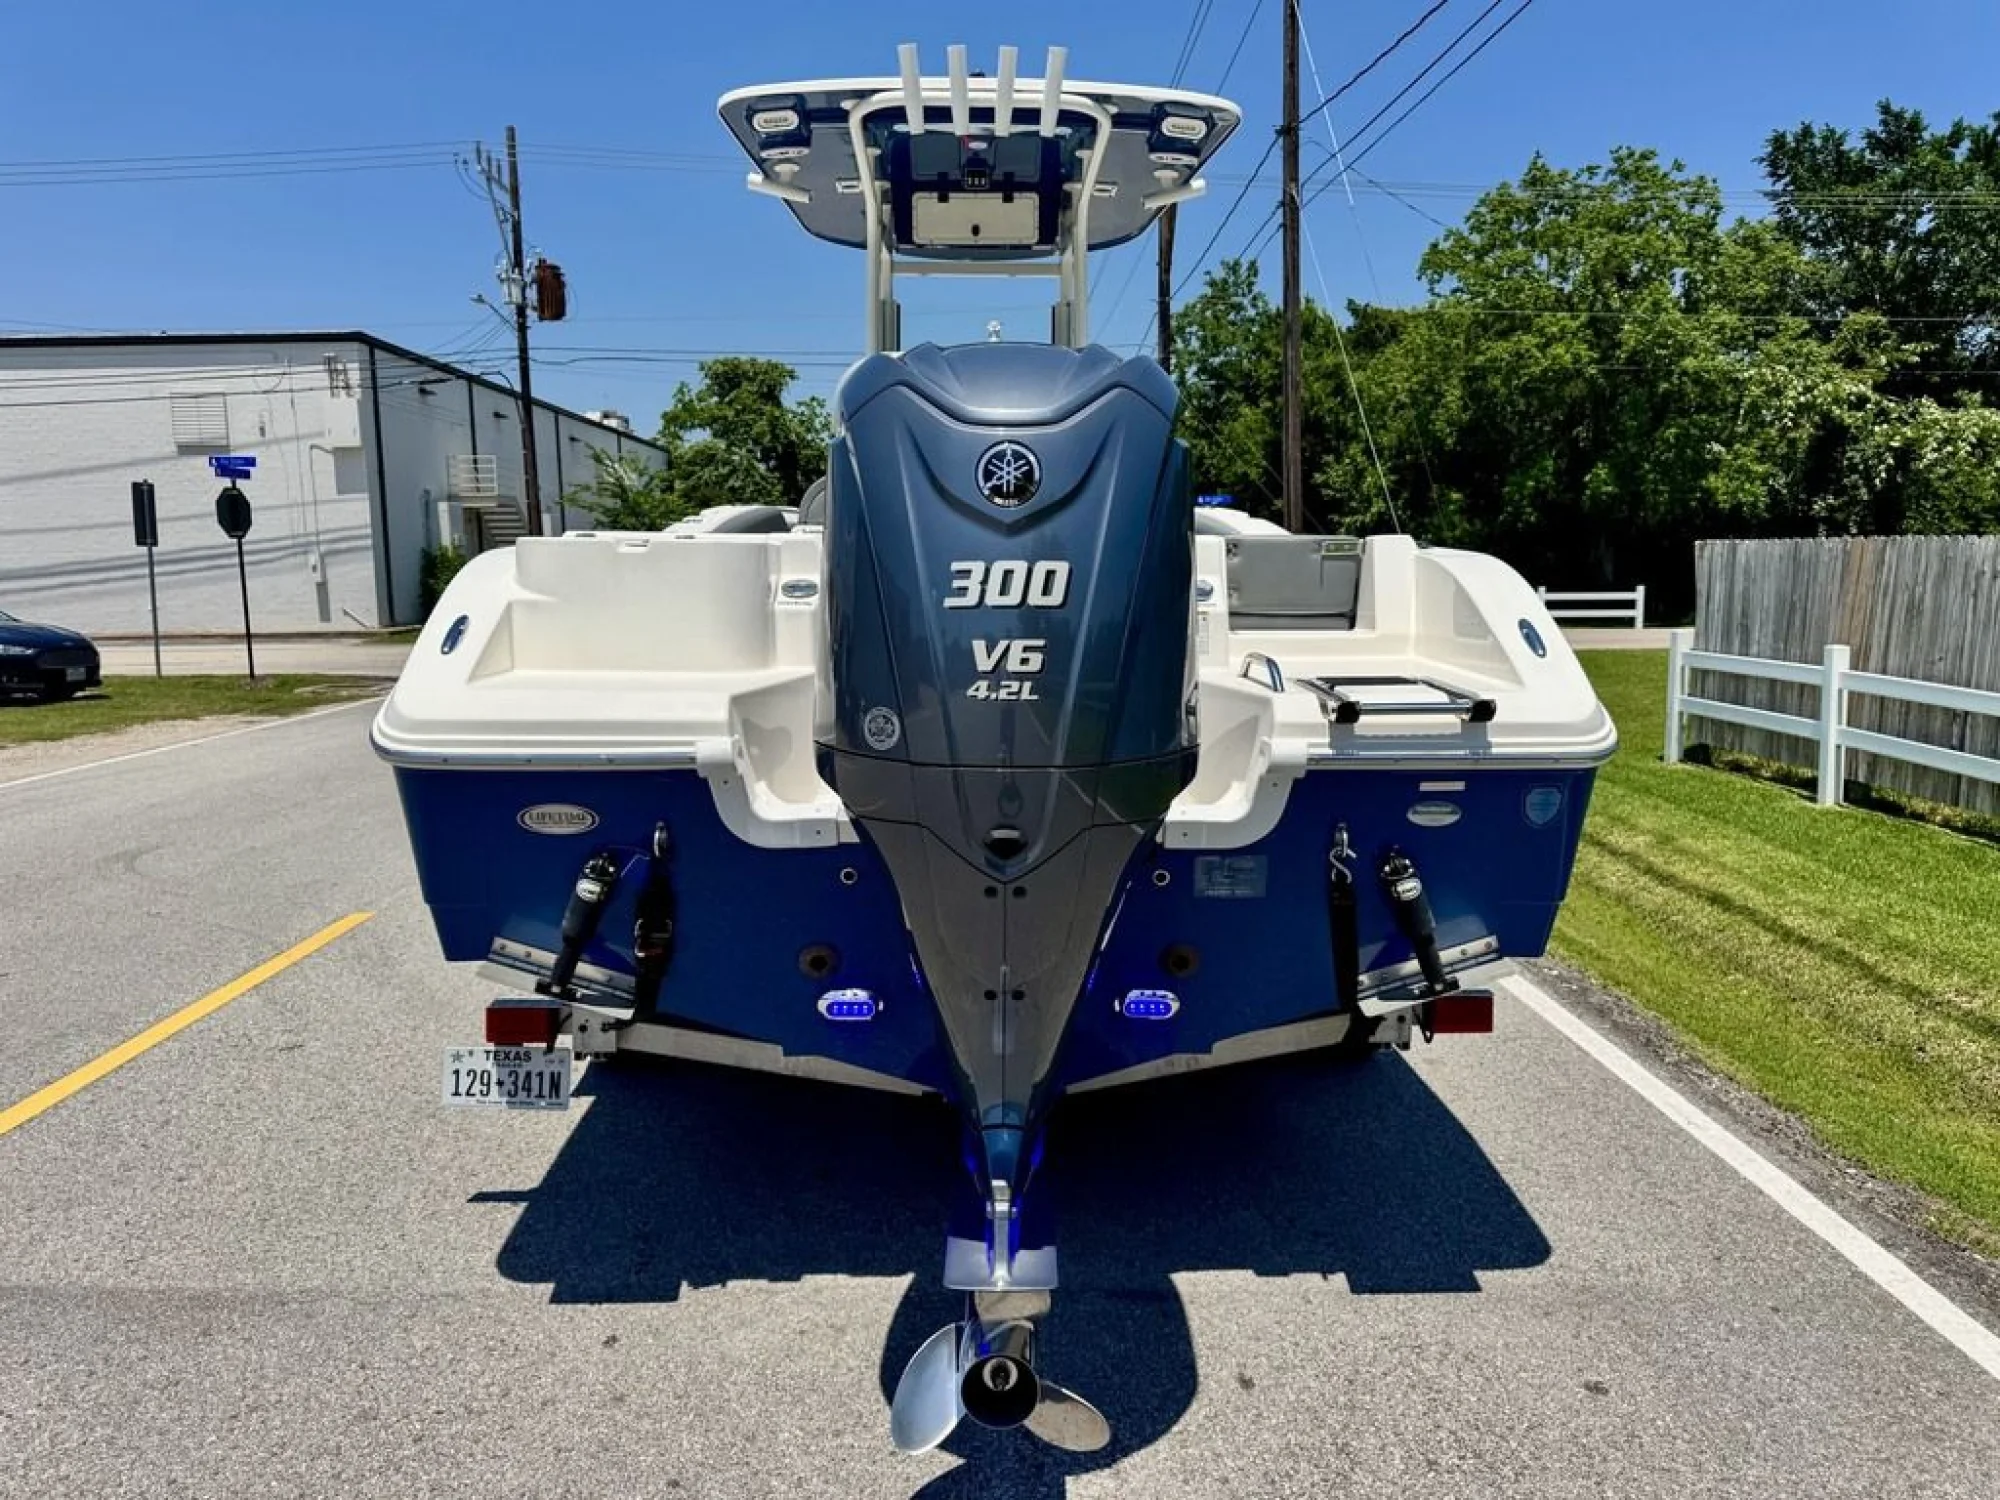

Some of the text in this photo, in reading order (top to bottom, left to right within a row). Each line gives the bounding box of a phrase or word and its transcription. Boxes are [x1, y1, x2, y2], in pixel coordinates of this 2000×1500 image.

[943, 560, 1070, 608] 300
[972, 639, 1046, 673] V6
[966, 680, 1039, 700] 4.2L
[484, 1050, 532, 1062] TEXAS
